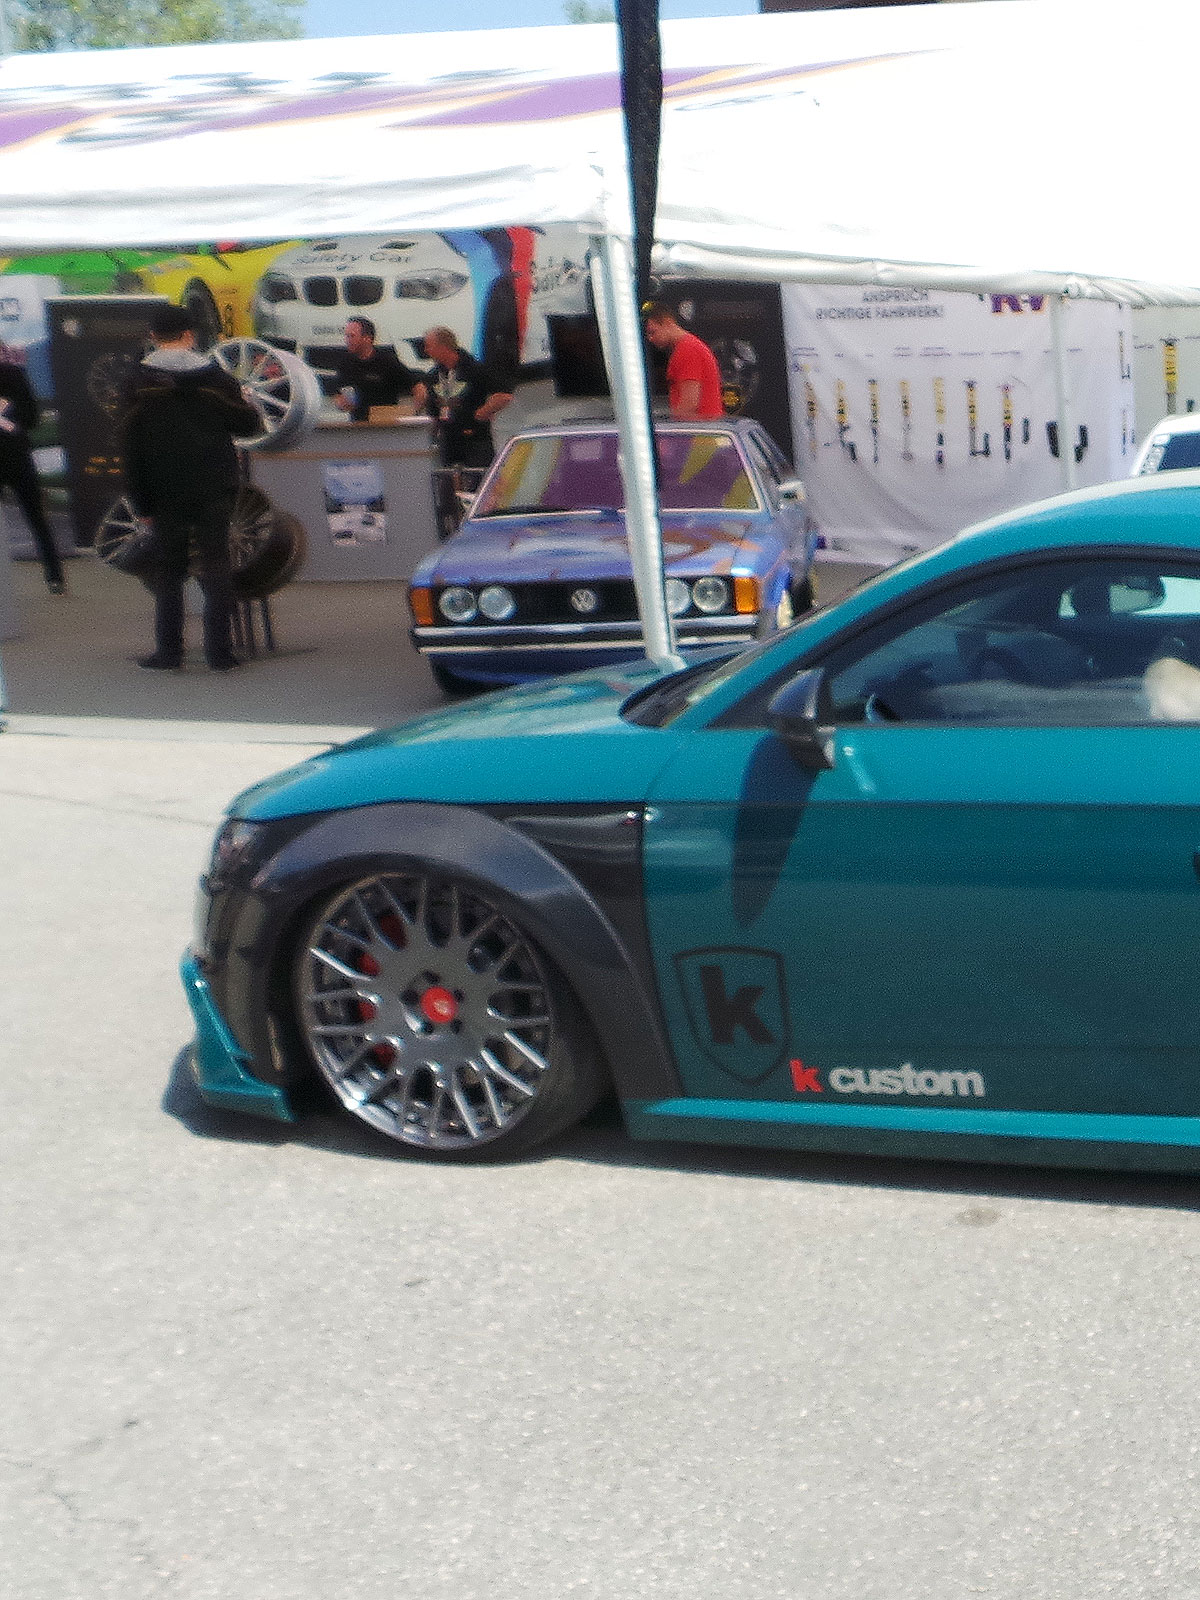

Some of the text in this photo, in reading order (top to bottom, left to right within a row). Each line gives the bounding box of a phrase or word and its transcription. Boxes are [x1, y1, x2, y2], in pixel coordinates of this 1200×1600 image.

[815, 307, 871, 320] RICHTIGE
[789, 1058, 985, 1097] k custom
